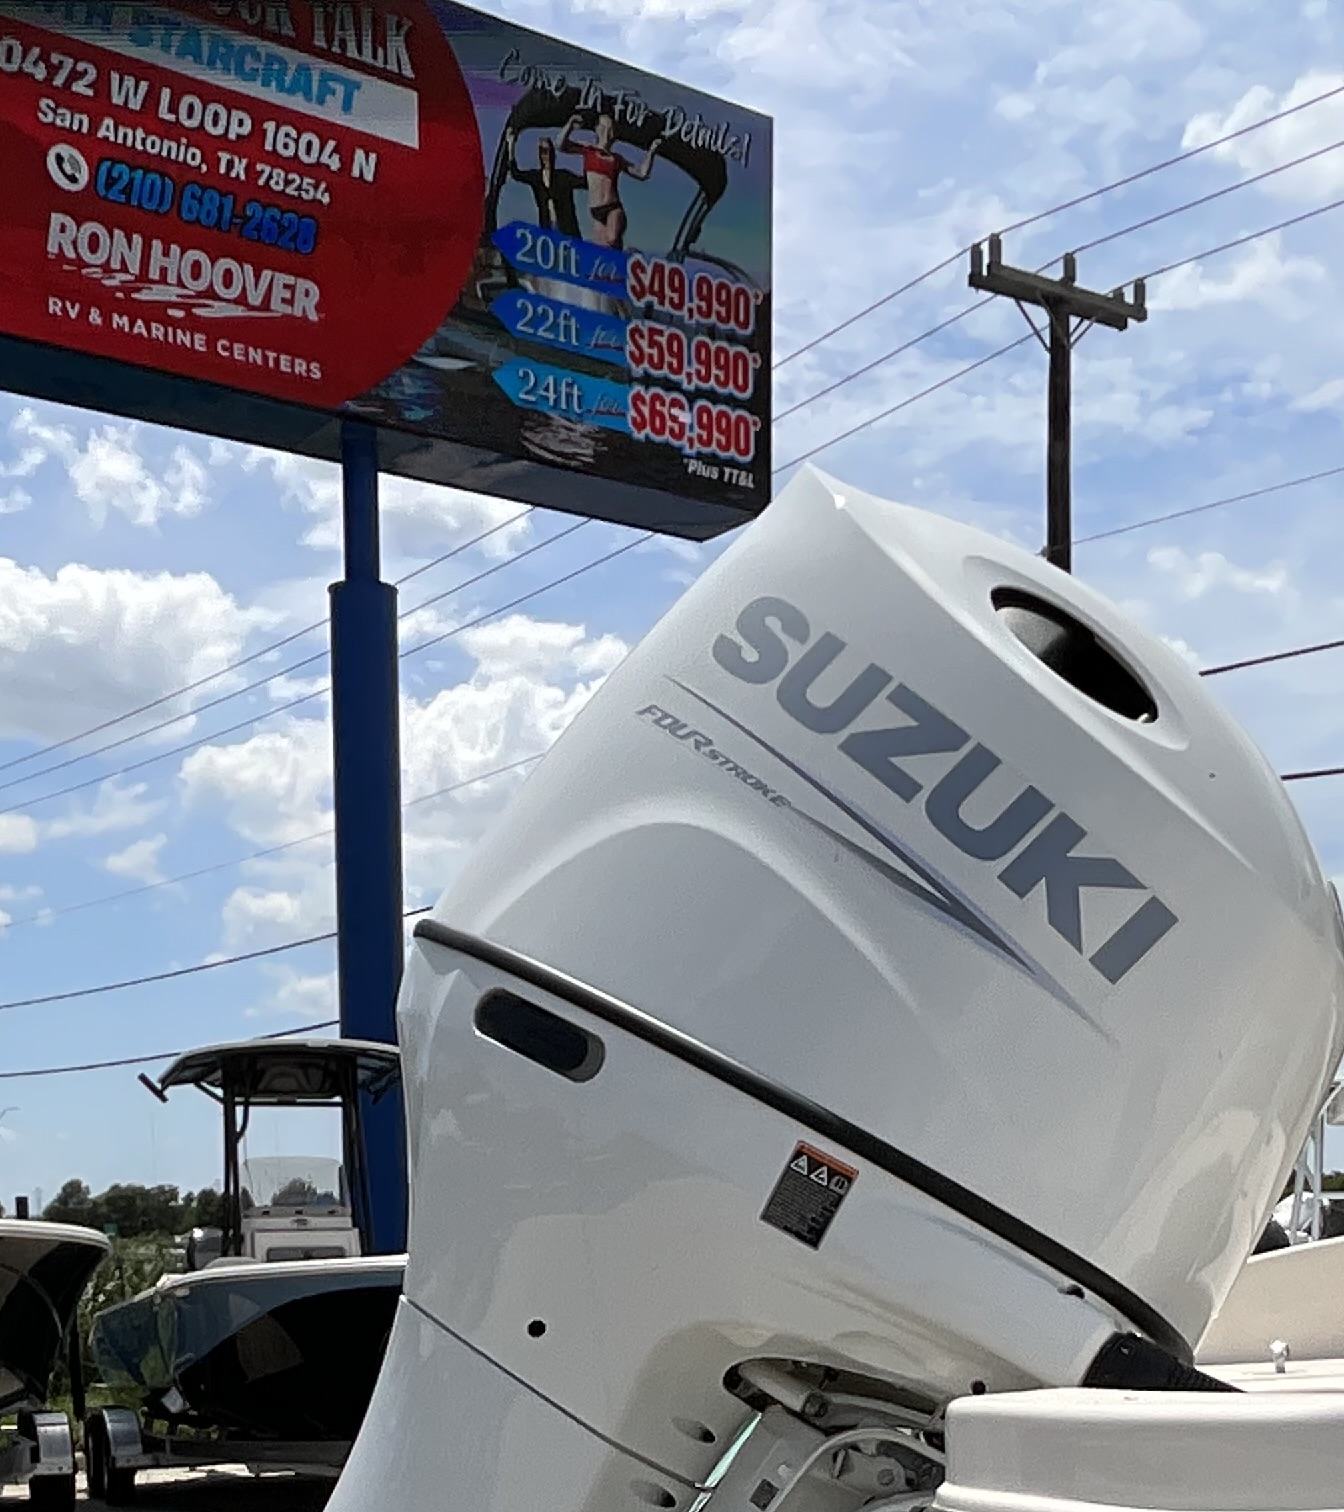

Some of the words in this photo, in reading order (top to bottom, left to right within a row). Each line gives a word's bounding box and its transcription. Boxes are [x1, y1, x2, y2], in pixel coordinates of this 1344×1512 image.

[499, 48, 569, 97] Come
[574, 76, 605, 113] In
[37, 98, 89, 134] San
[97, 115, 208, 174] Antonio,
[217, 151, 248, 181] TX
[256, 163, 332, 206] 78254
[110, 70, 150, 112] W
[158, 86, 253, 141] LOOP
[262, 119, 342, 172] 1604
[351, 146, 378, 183] N
[96, 160, 175, 214] (210)
[179, 183, 319, 254] 681-2628
[47, 212, 143, 275] RON
[148, 238, 322, 323] HOOVER
[514, 228, 581, 279] 20ft
[48, 296, 81, 320] RV
[88, 307, 103, 326] &
[112, 312, 208, 352] MARINE
[216, 338, 323, 380] CENTERS
[514, 300, 581, 347] 22ft
[518, 367, 584, 415] 24ft
[635, 704, 714, 752] FOUR
[711, 595, 1179, 985] SUZUKI
